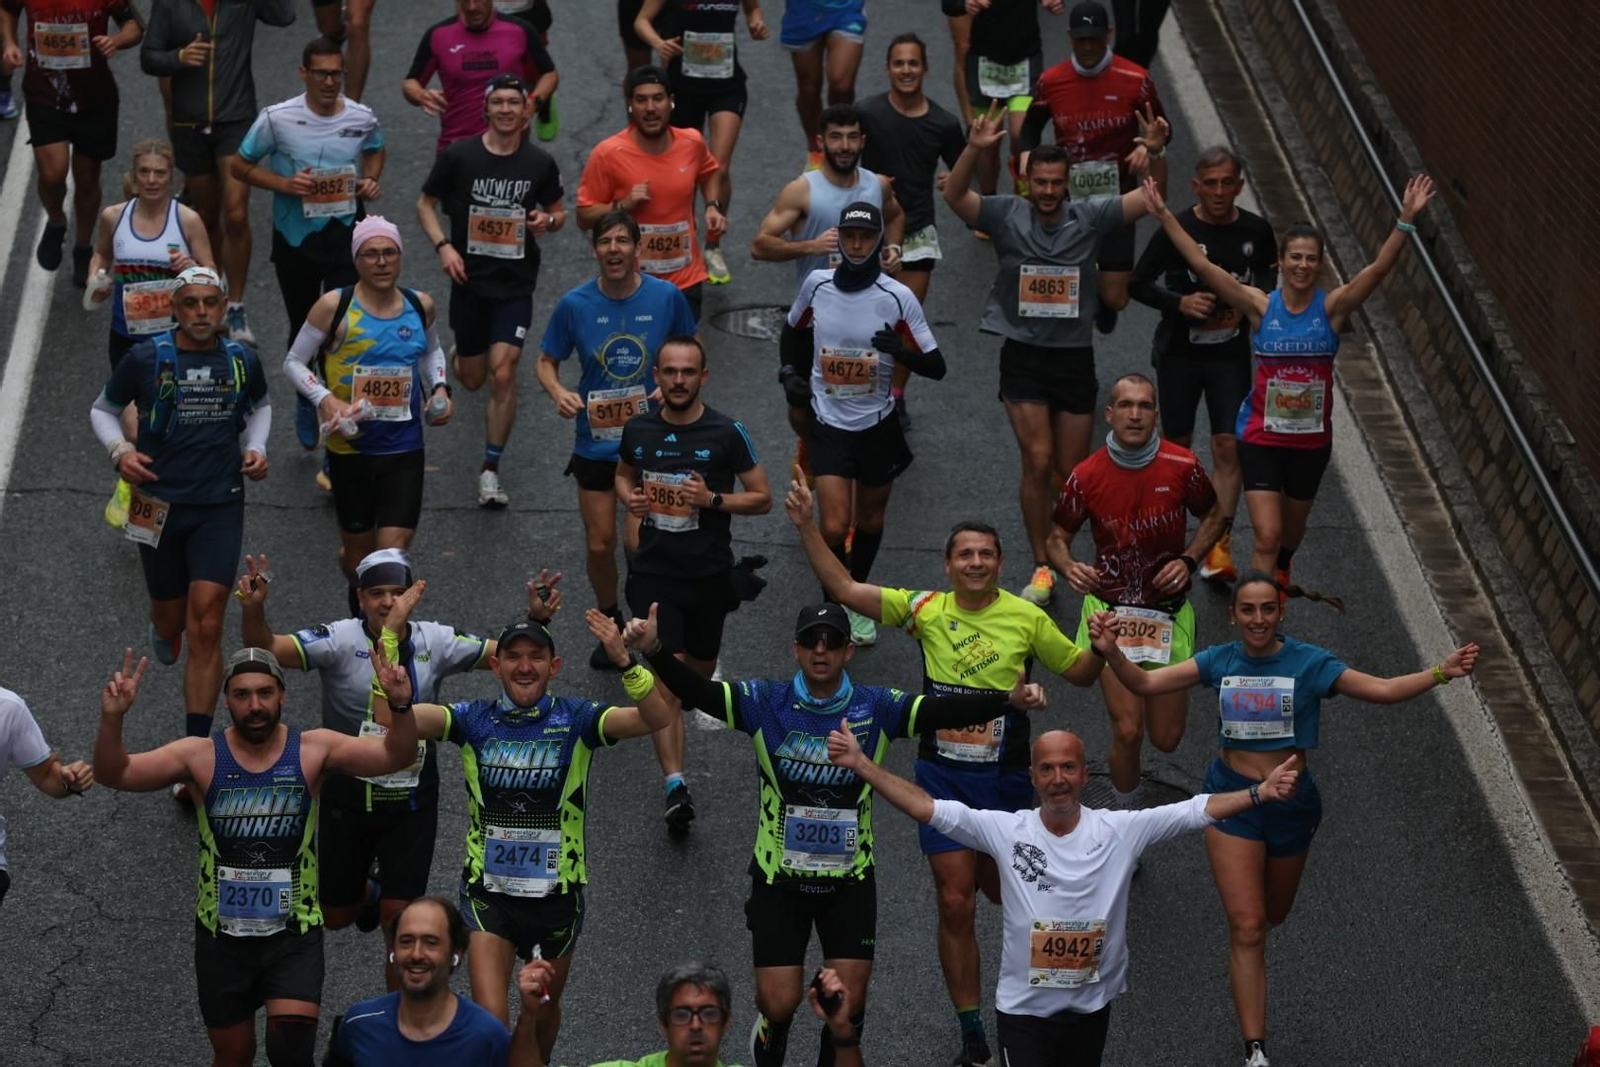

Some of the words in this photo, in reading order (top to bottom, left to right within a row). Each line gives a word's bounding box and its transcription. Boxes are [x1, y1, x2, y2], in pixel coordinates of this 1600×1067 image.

[43, 36, 76, 49] 4654
[472, 178, 532, 203] ANTWERP
[845, 210, 872, 220] HOKA
[477, 219, 513, 236] 4537
[647, 236, 680, 252] 4624
[1028, 279, 1066, 295] 4863
[828, 361, 864, 377] 4672
[363, 380, 400, 397] 4823
[596, 401, 633, 420] 5173
[649, 486, 686, 507] 3863
[1118, 621, 1157, 639] 5302
[960, 653, 1000, 680] ATLETISMO
[1232, 692, 1277, 711] 1794
[480, 738, 562, 769] AMATE
[481, 766, 561, 789] RUNNERS
[778, 758, 860, 785] RUNNER
[210, 785, 305, 817] AMATE
[212, 815, 304, 838] RUNNERS
[796, 823, 840, 844] 3203
[494, 844, 541, 866] 2474
[226, 885, 273, 907] 2370
[799, 884, 837, 894] SEVILLA
[1042, 937, 1090, 957] 4942
